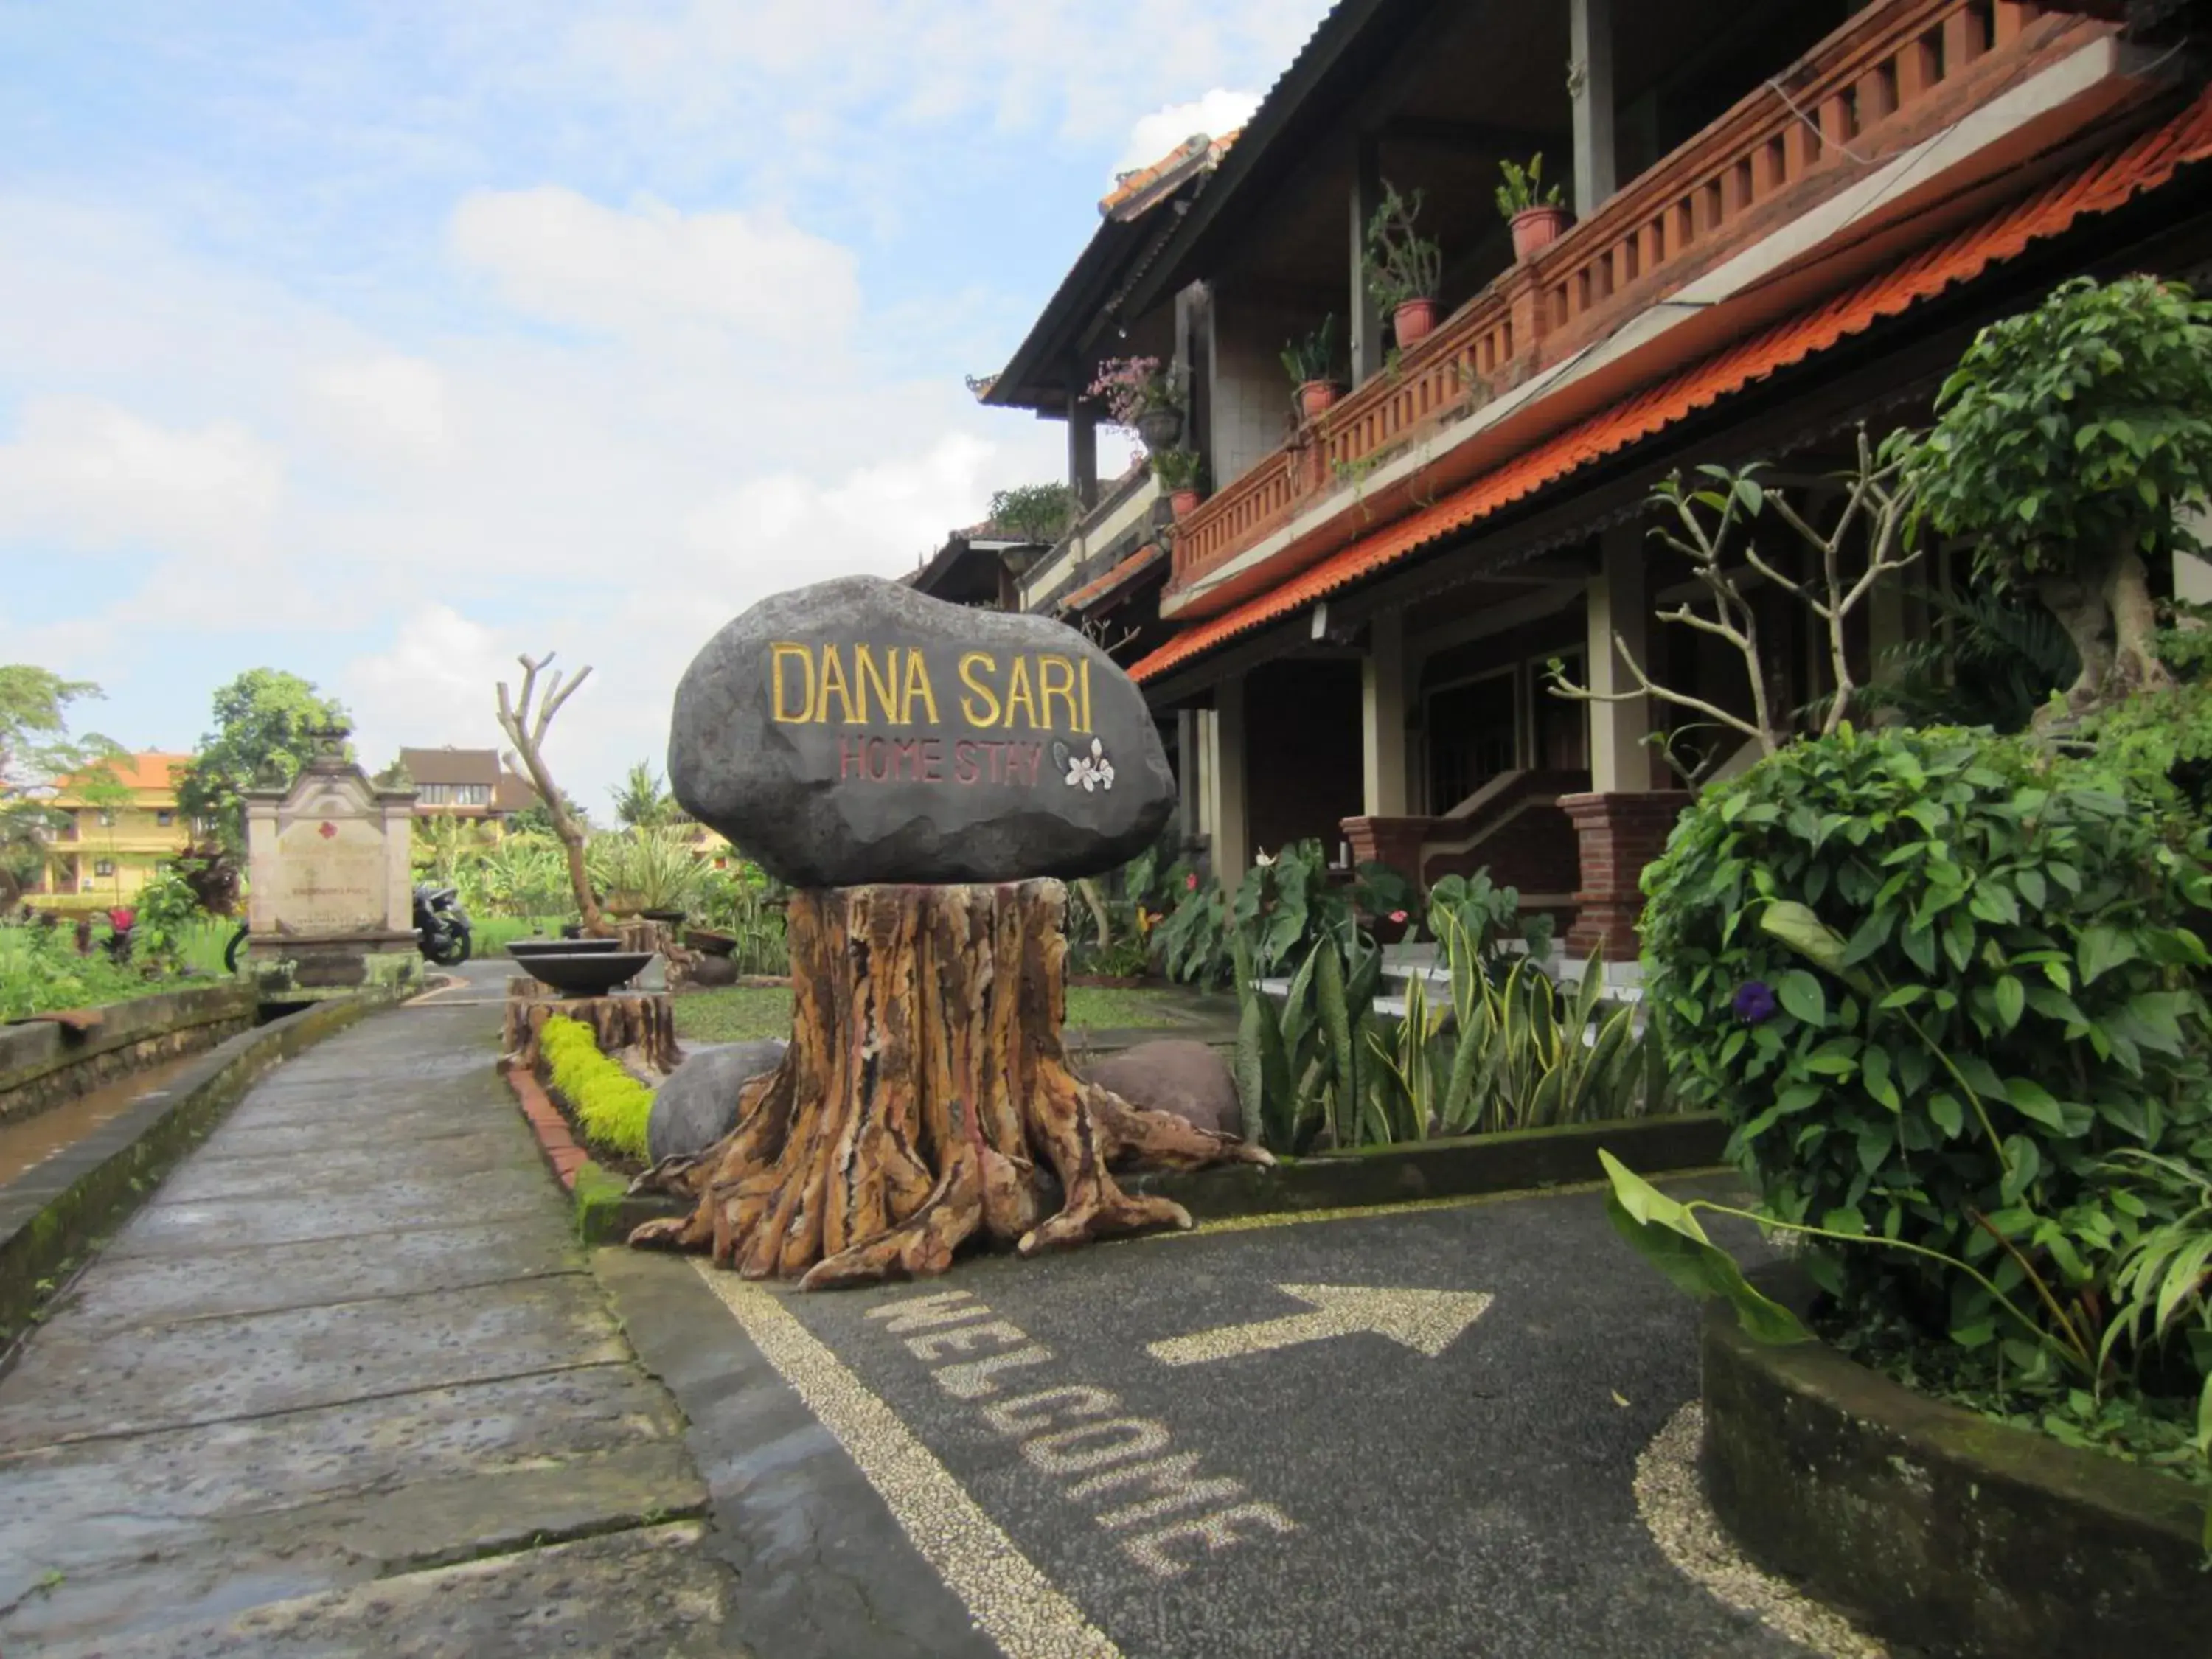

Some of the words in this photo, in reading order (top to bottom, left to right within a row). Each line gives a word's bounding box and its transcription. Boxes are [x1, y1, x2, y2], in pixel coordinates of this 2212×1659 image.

[769, 641, 939, 726] DANA
[959, 652, 1093, 734] SARI
[838, 733, 943, 785] HOME
[953, 740, 1042, 786] STAY
[863, 1290, 1301, 1578] WELCOME
